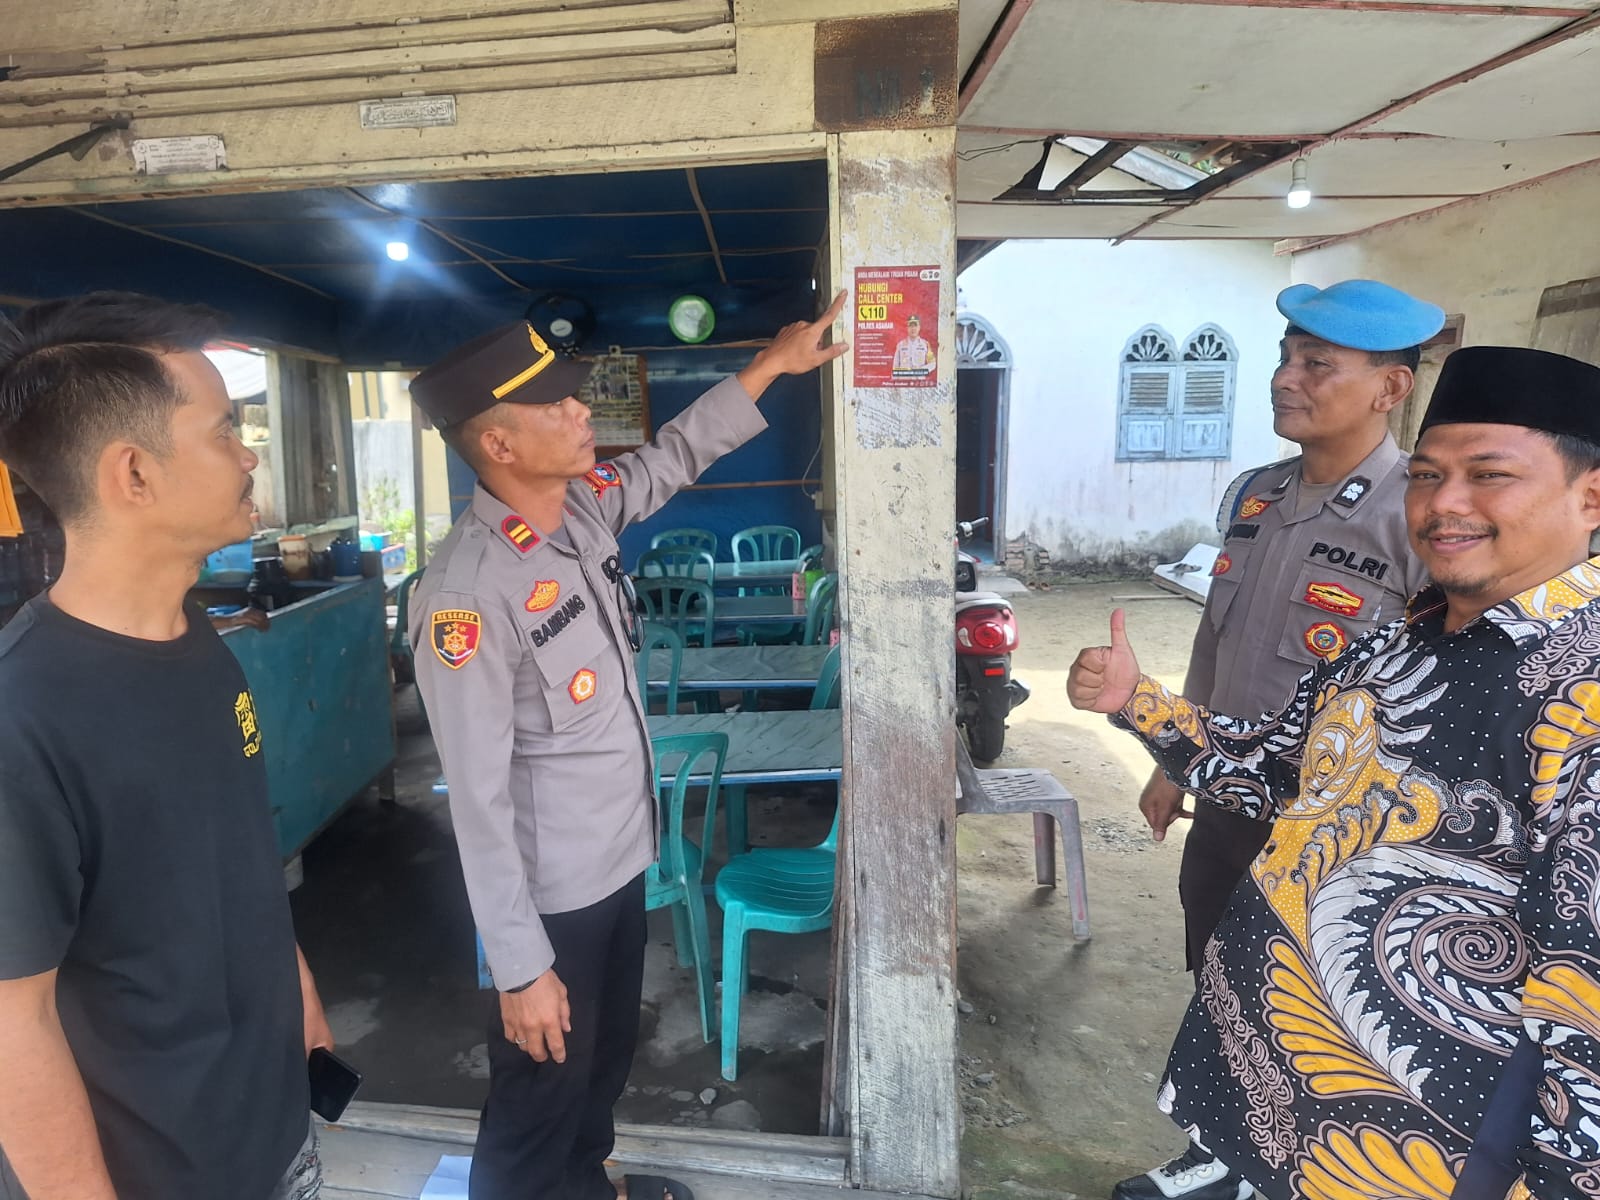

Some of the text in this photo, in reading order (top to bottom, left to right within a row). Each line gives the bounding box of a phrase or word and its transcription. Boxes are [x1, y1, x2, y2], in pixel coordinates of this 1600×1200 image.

[858, 282, 888, 293] HUBUNGI
[858, 293, 903, 304] CALL CENTER
[868, 306, 884, 319] 110
[1309, 542, 1389, 580] POLRI
[436, 611, 475, 621] RESERSE
[531, 594, 586, 647] BAMBANG
